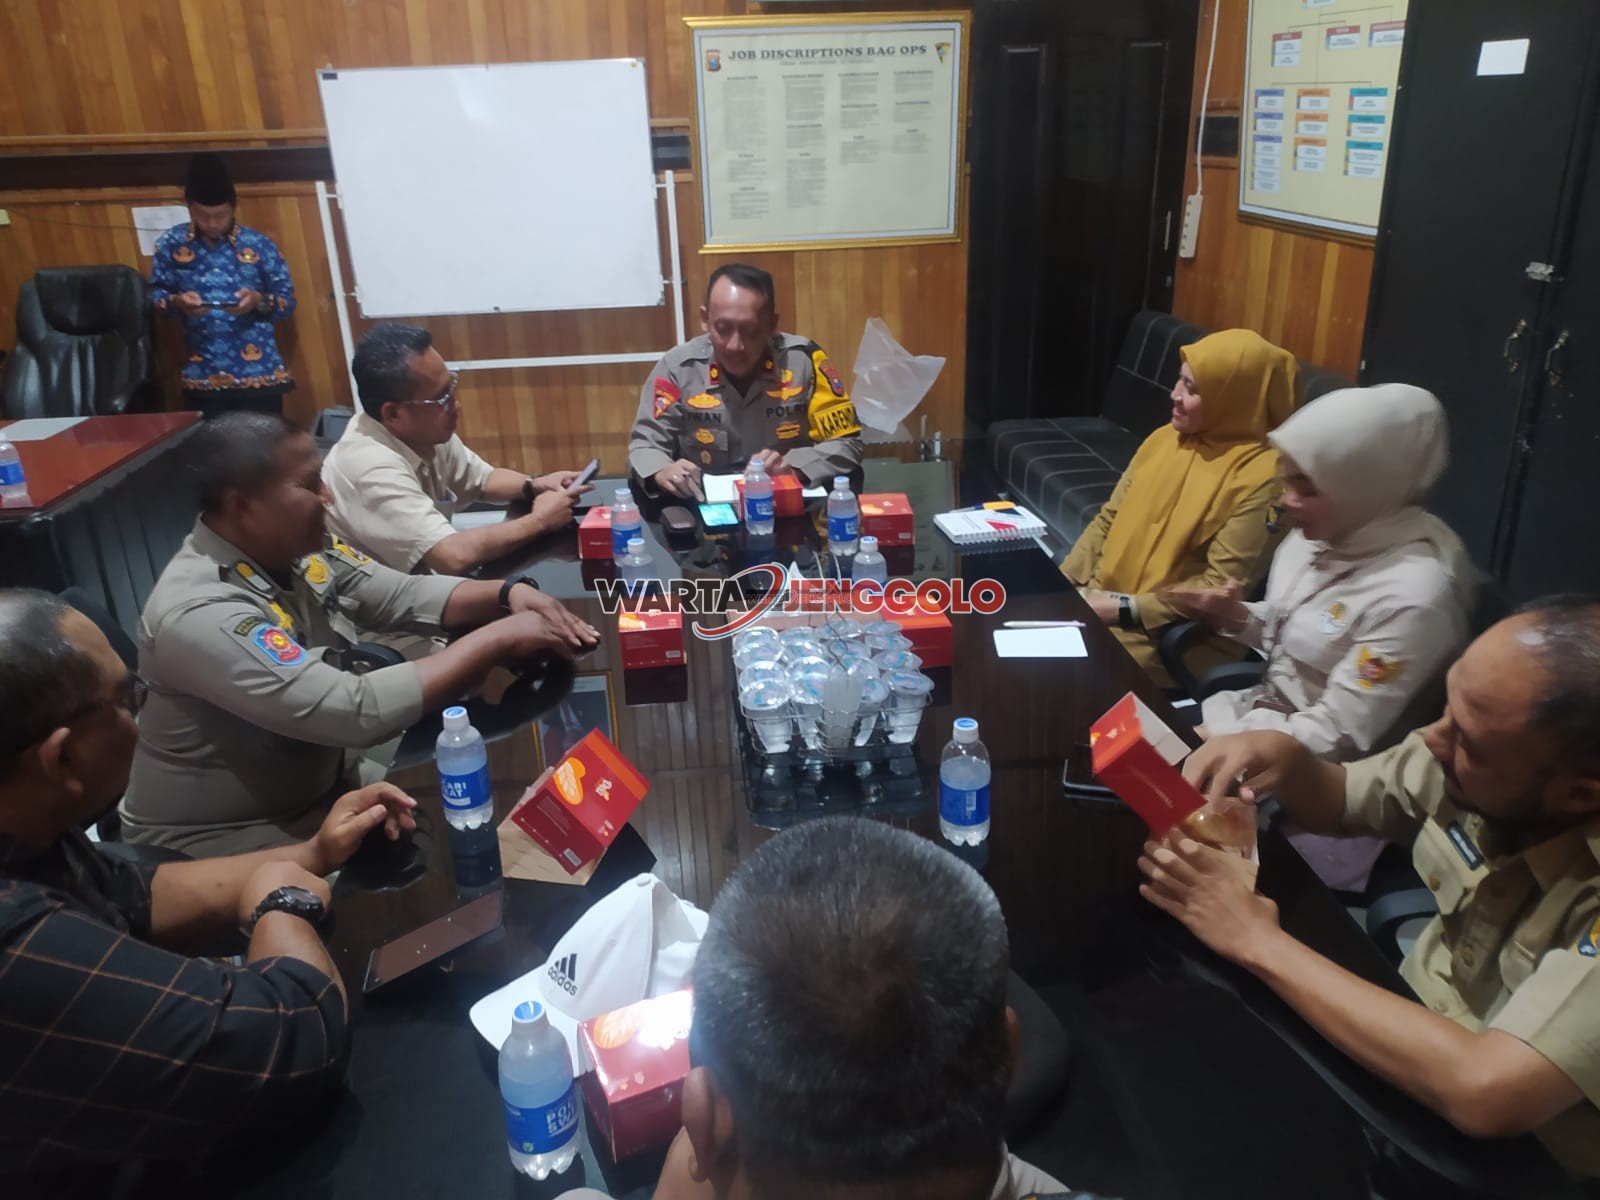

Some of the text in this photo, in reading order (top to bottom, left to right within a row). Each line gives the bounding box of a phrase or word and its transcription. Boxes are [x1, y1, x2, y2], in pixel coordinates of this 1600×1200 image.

[728, 44, 928, 61] JOB DISCRIPTIONS BAG OPS
[547, 965, 578, 996] adidas
